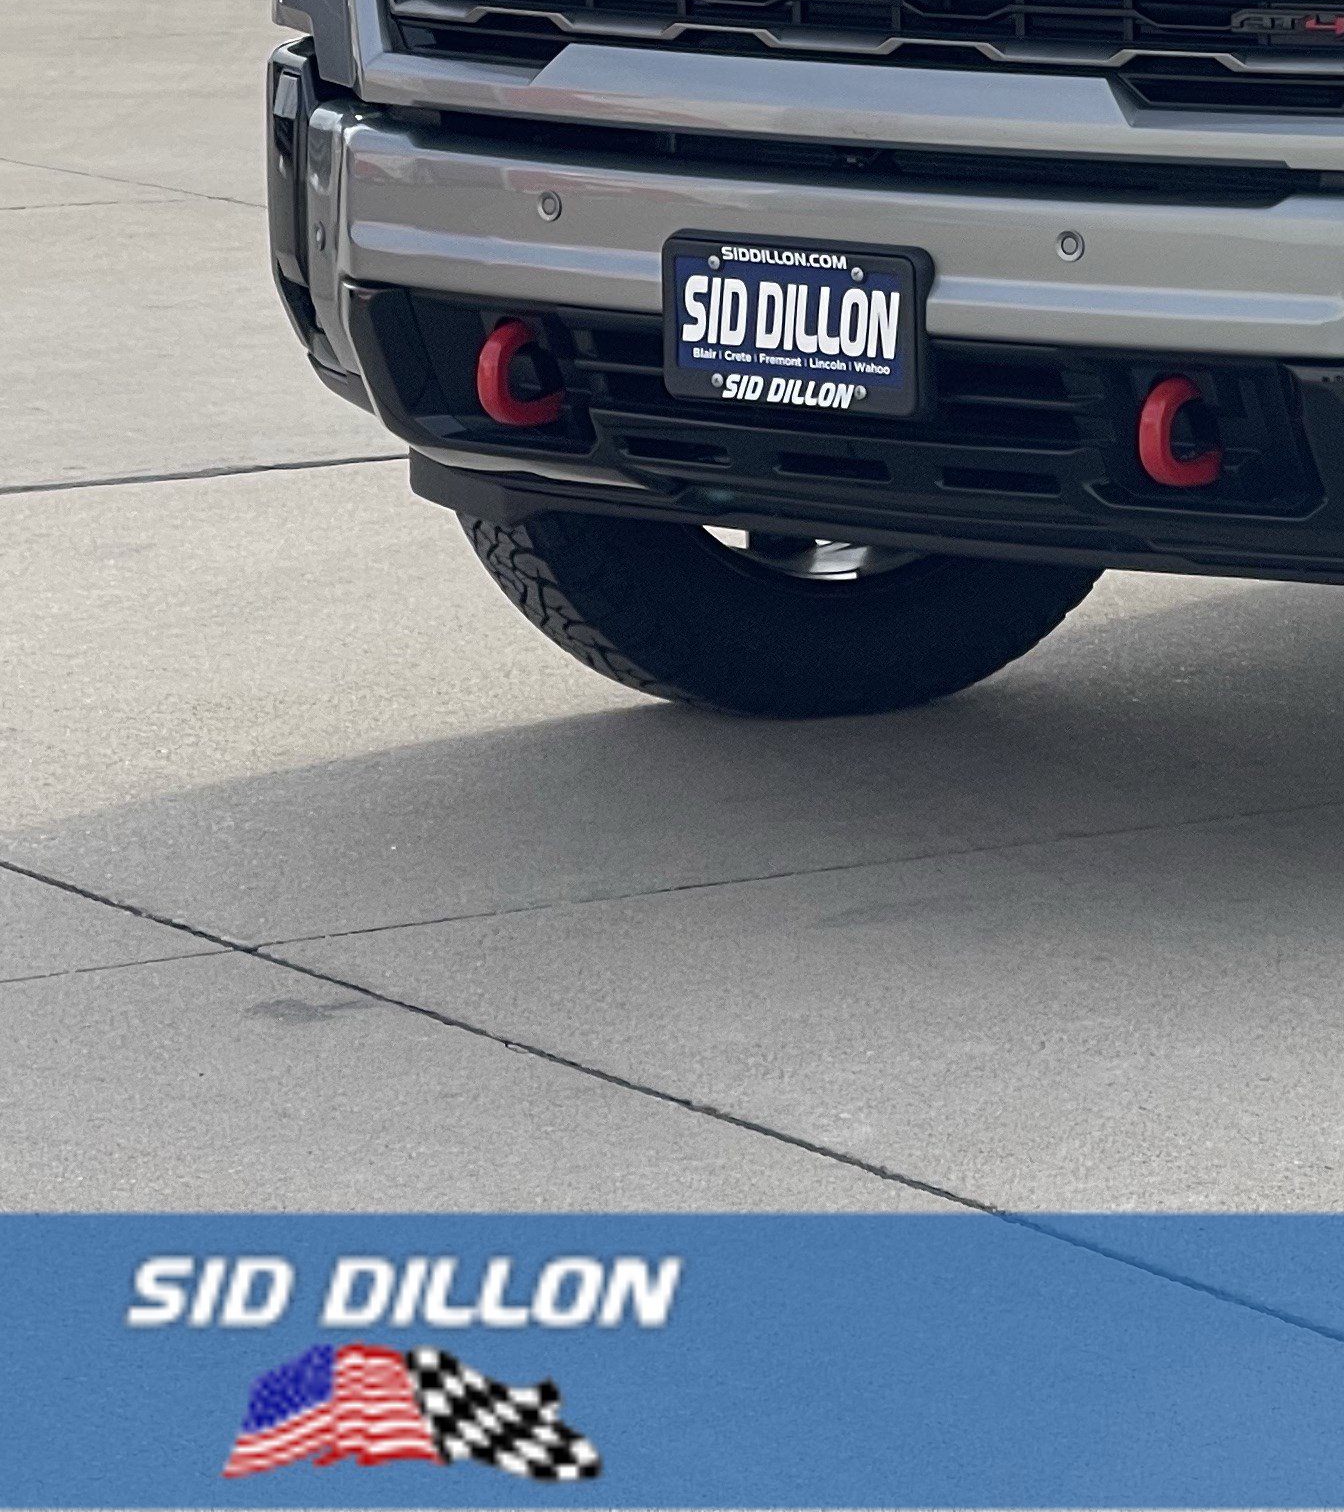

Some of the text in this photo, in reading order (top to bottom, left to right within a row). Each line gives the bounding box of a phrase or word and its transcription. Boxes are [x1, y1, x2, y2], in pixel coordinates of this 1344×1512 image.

[720, 246, 848, 271] SIDDILLON.COM
[681, 274, 900, 360] SID DILLON
[692, 347, 891, 376] Blair Crete Fremont Lincoln Wahoo
[721, 373, 855, 410] SID DILLON
